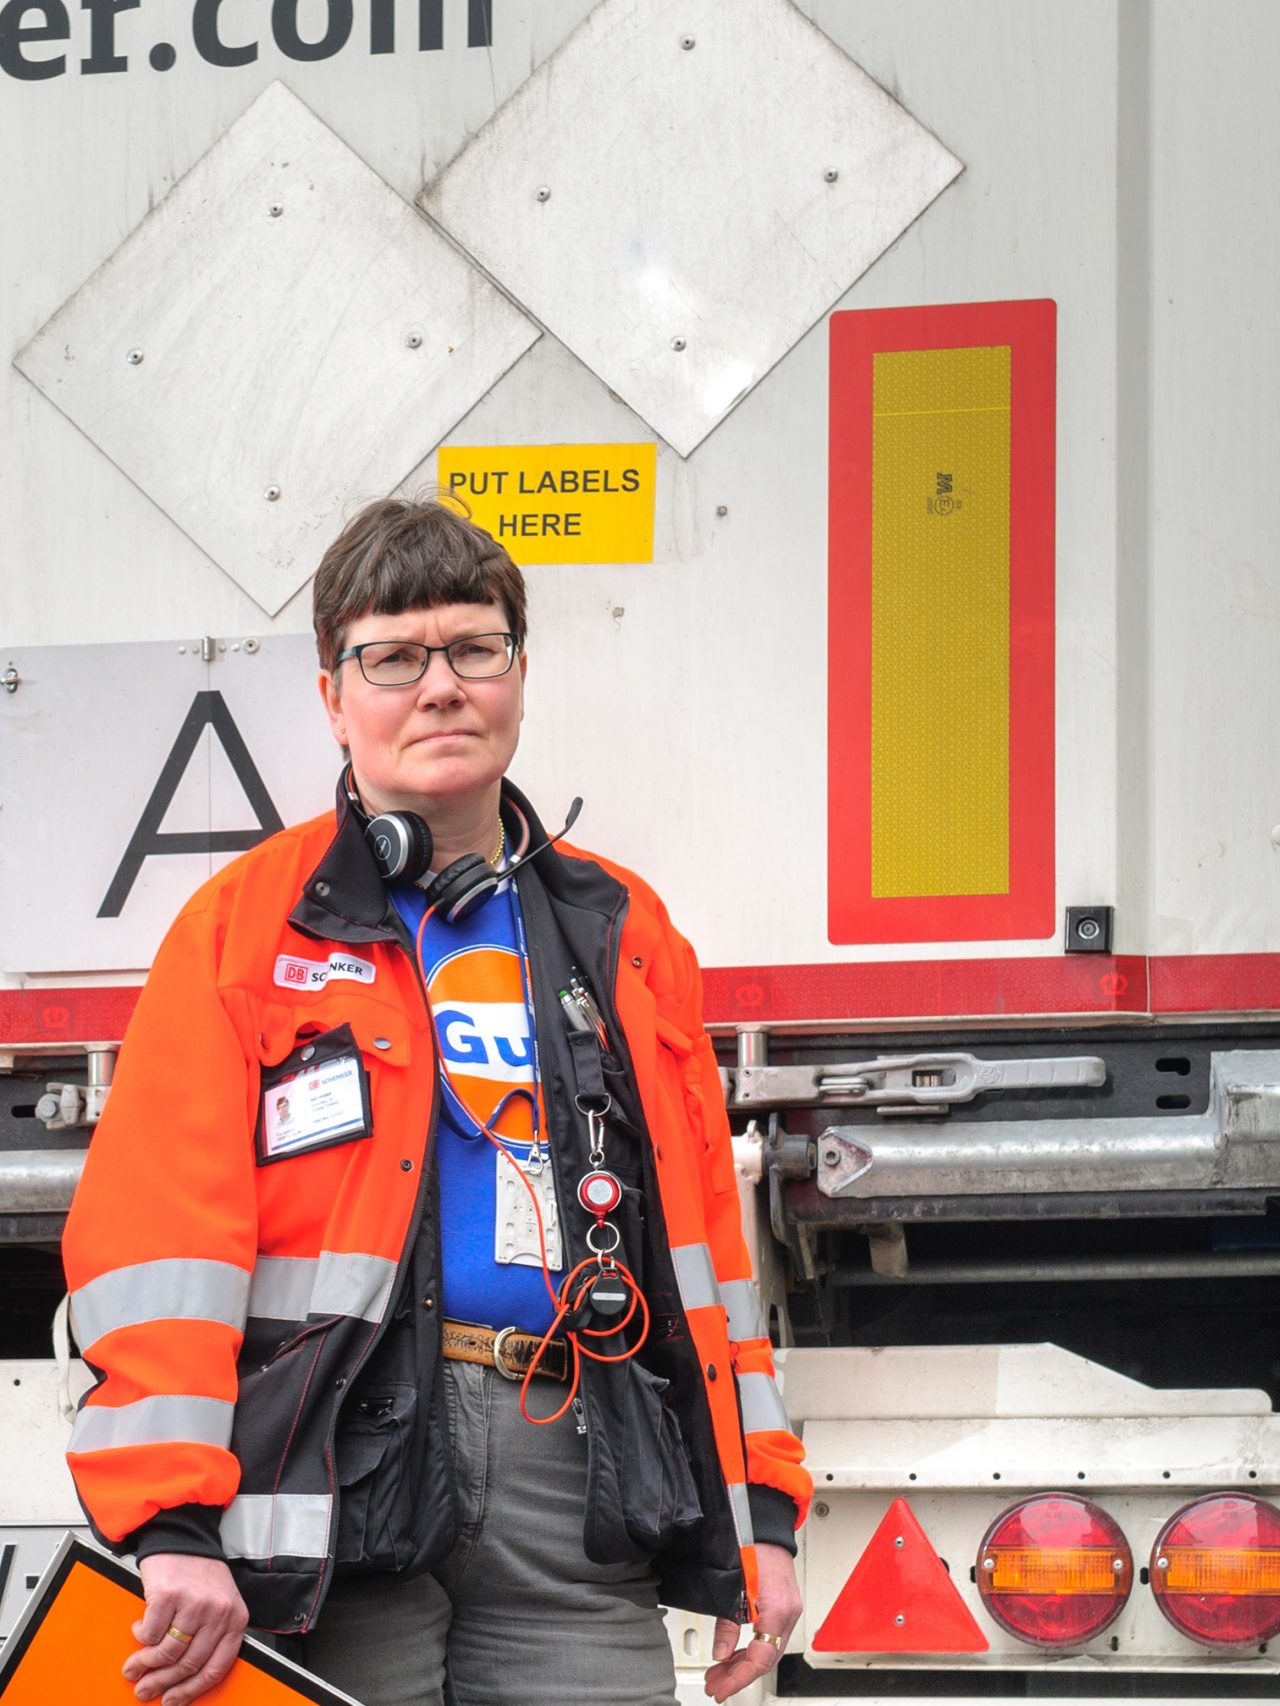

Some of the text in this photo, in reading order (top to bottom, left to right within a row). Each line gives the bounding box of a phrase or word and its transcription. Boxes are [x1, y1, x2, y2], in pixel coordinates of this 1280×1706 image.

[449, 469, 640, 495] PUT LABELS
[499, 513, 582, 537] HERE
[96, 690, 287, 919] A
[286, 965, 306, 982] DB
